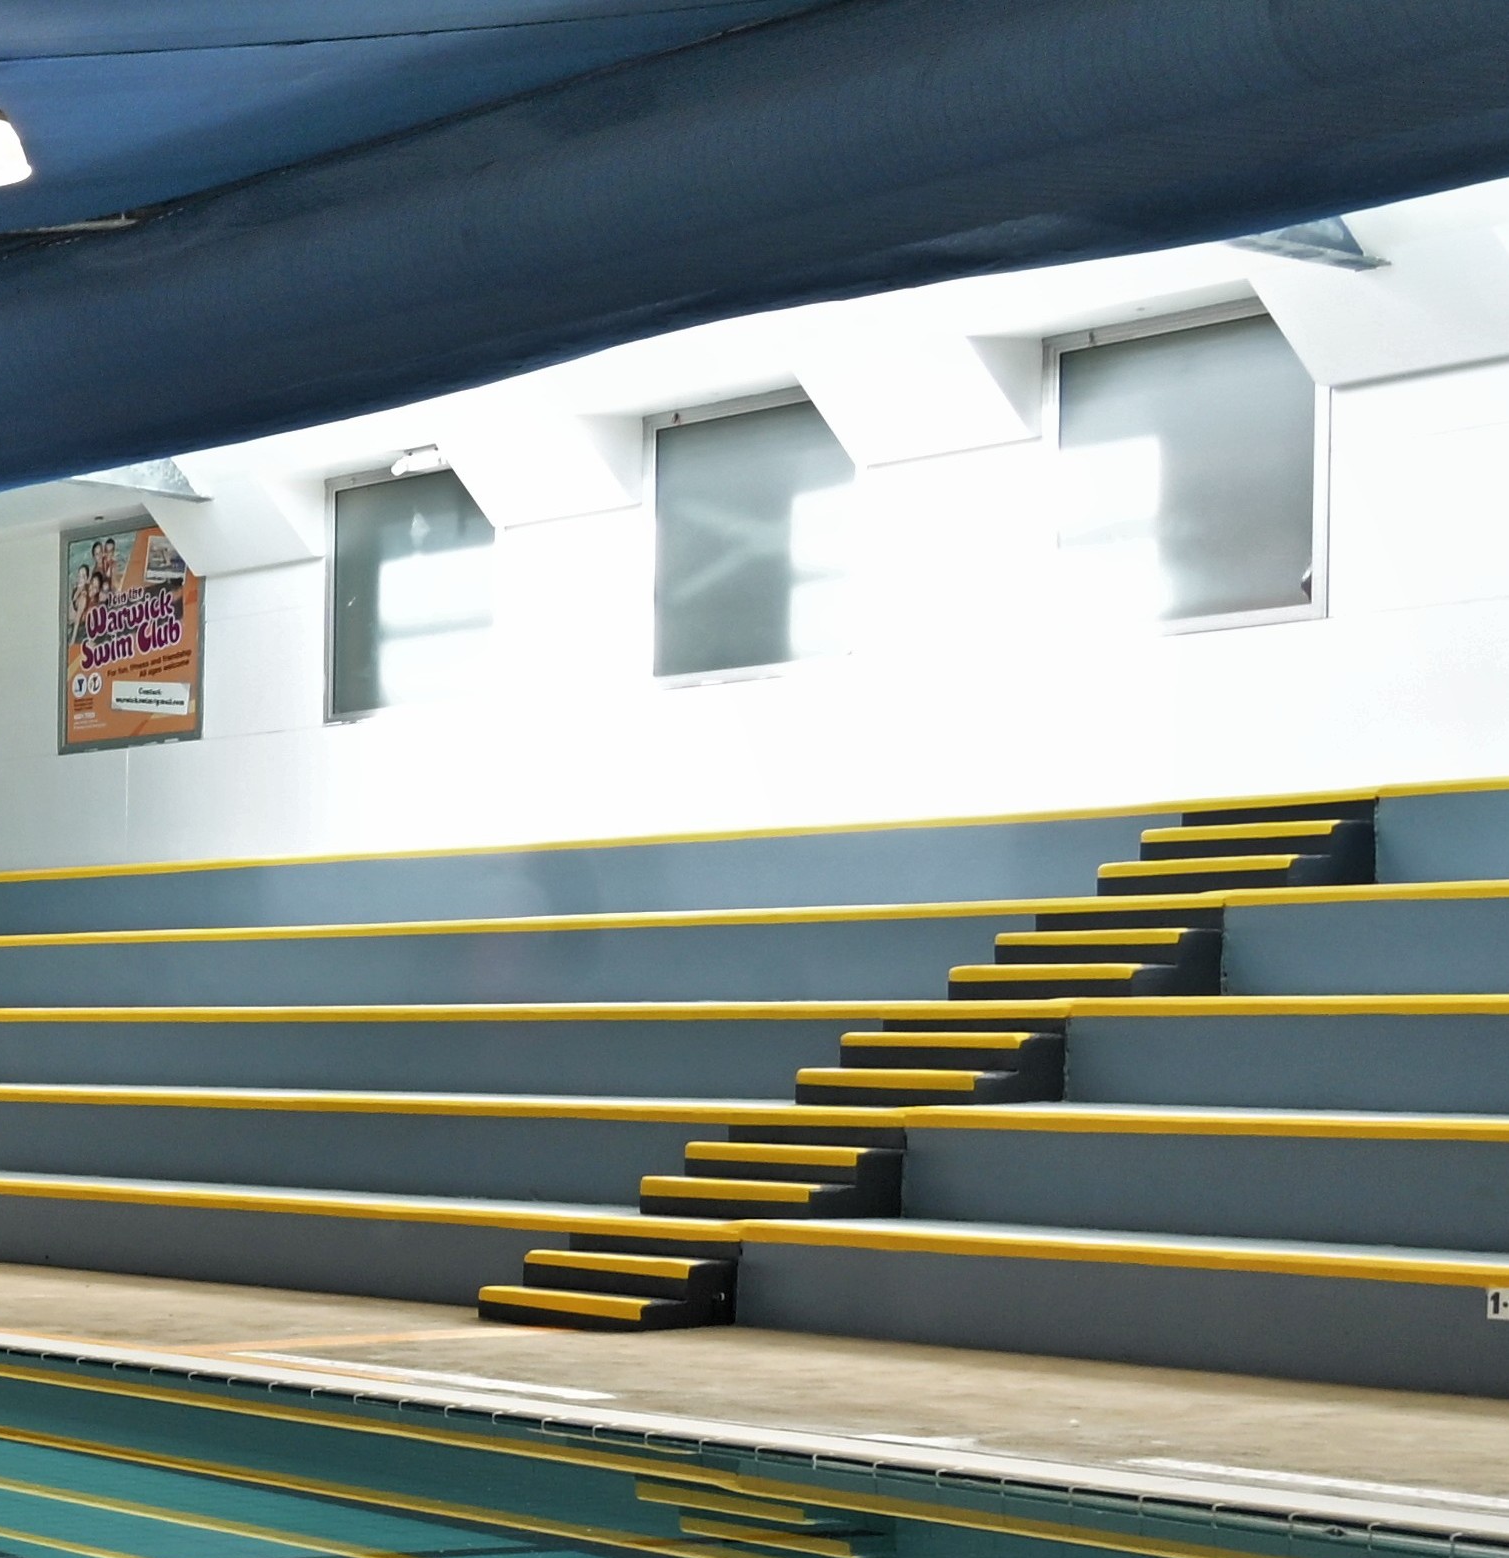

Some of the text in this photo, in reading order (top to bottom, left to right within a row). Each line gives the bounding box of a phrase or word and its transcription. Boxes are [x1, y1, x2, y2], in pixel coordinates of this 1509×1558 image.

[86, 588, 173, 639] Warwick
[105, 587, 145, 608] Join the
[80, 615, 181, 670] Swim Club
